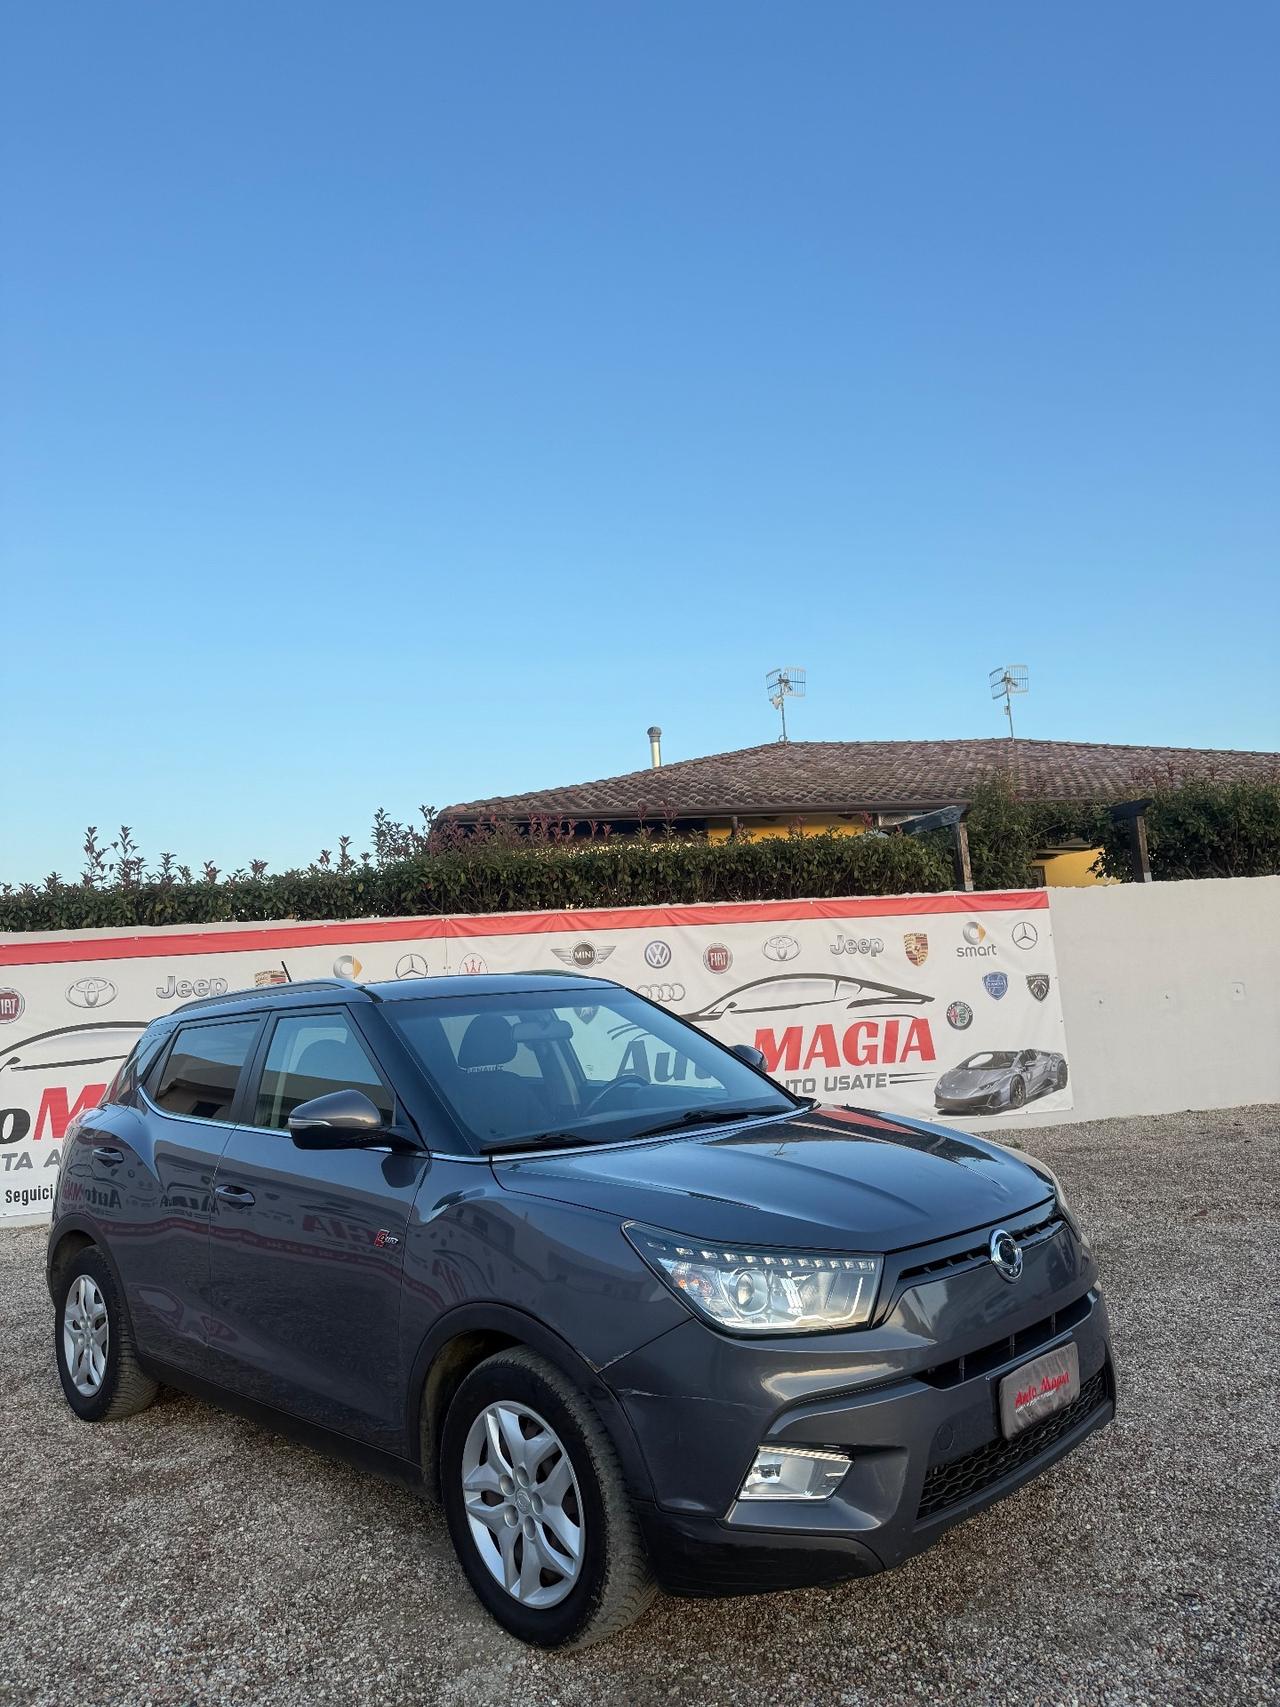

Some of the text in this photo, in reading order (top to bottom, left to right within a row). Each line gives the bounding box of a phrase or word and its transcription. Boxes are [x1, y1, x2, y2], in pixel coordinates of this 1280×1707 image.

[829, 934, 884, 957] Jeep
[956, 944, 997, 957] smart
[574, 950, 594, 959] MINI
[709, 951, 727, 966] FIAT
[155, 975, 228, 999] Jeep
[0, 998, 18, 1014] IAT
[754, 1018, 936, 1073] MAGIA
[824, 1073, 887, 1092] USATE
